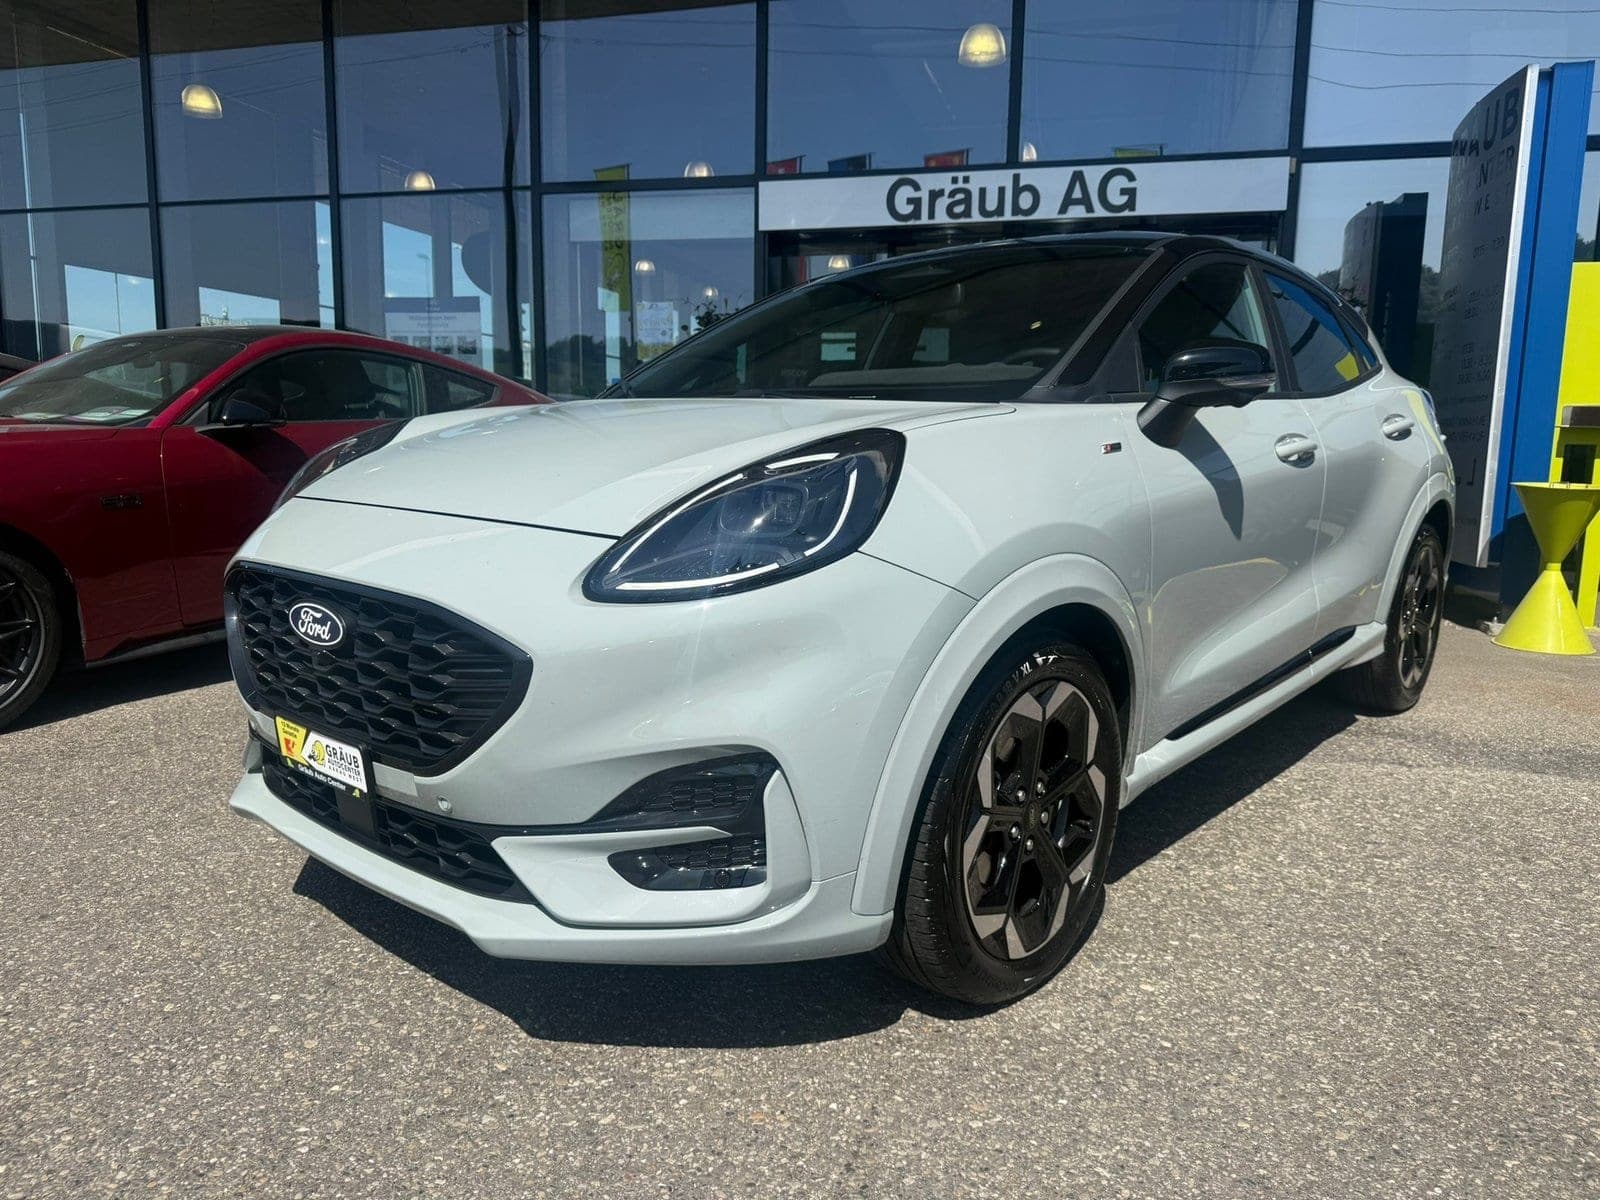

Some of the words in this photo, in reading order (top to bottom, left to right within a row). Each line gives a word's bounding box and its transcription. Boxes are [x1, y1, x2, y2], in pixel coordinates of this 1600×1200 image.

[885, 172, 1041, 223] Gräub
[1057, 167, 1138, 216] AG
[297, 606, 332, 641] Ford
[325, 744, 360, 769] GRÄUB
